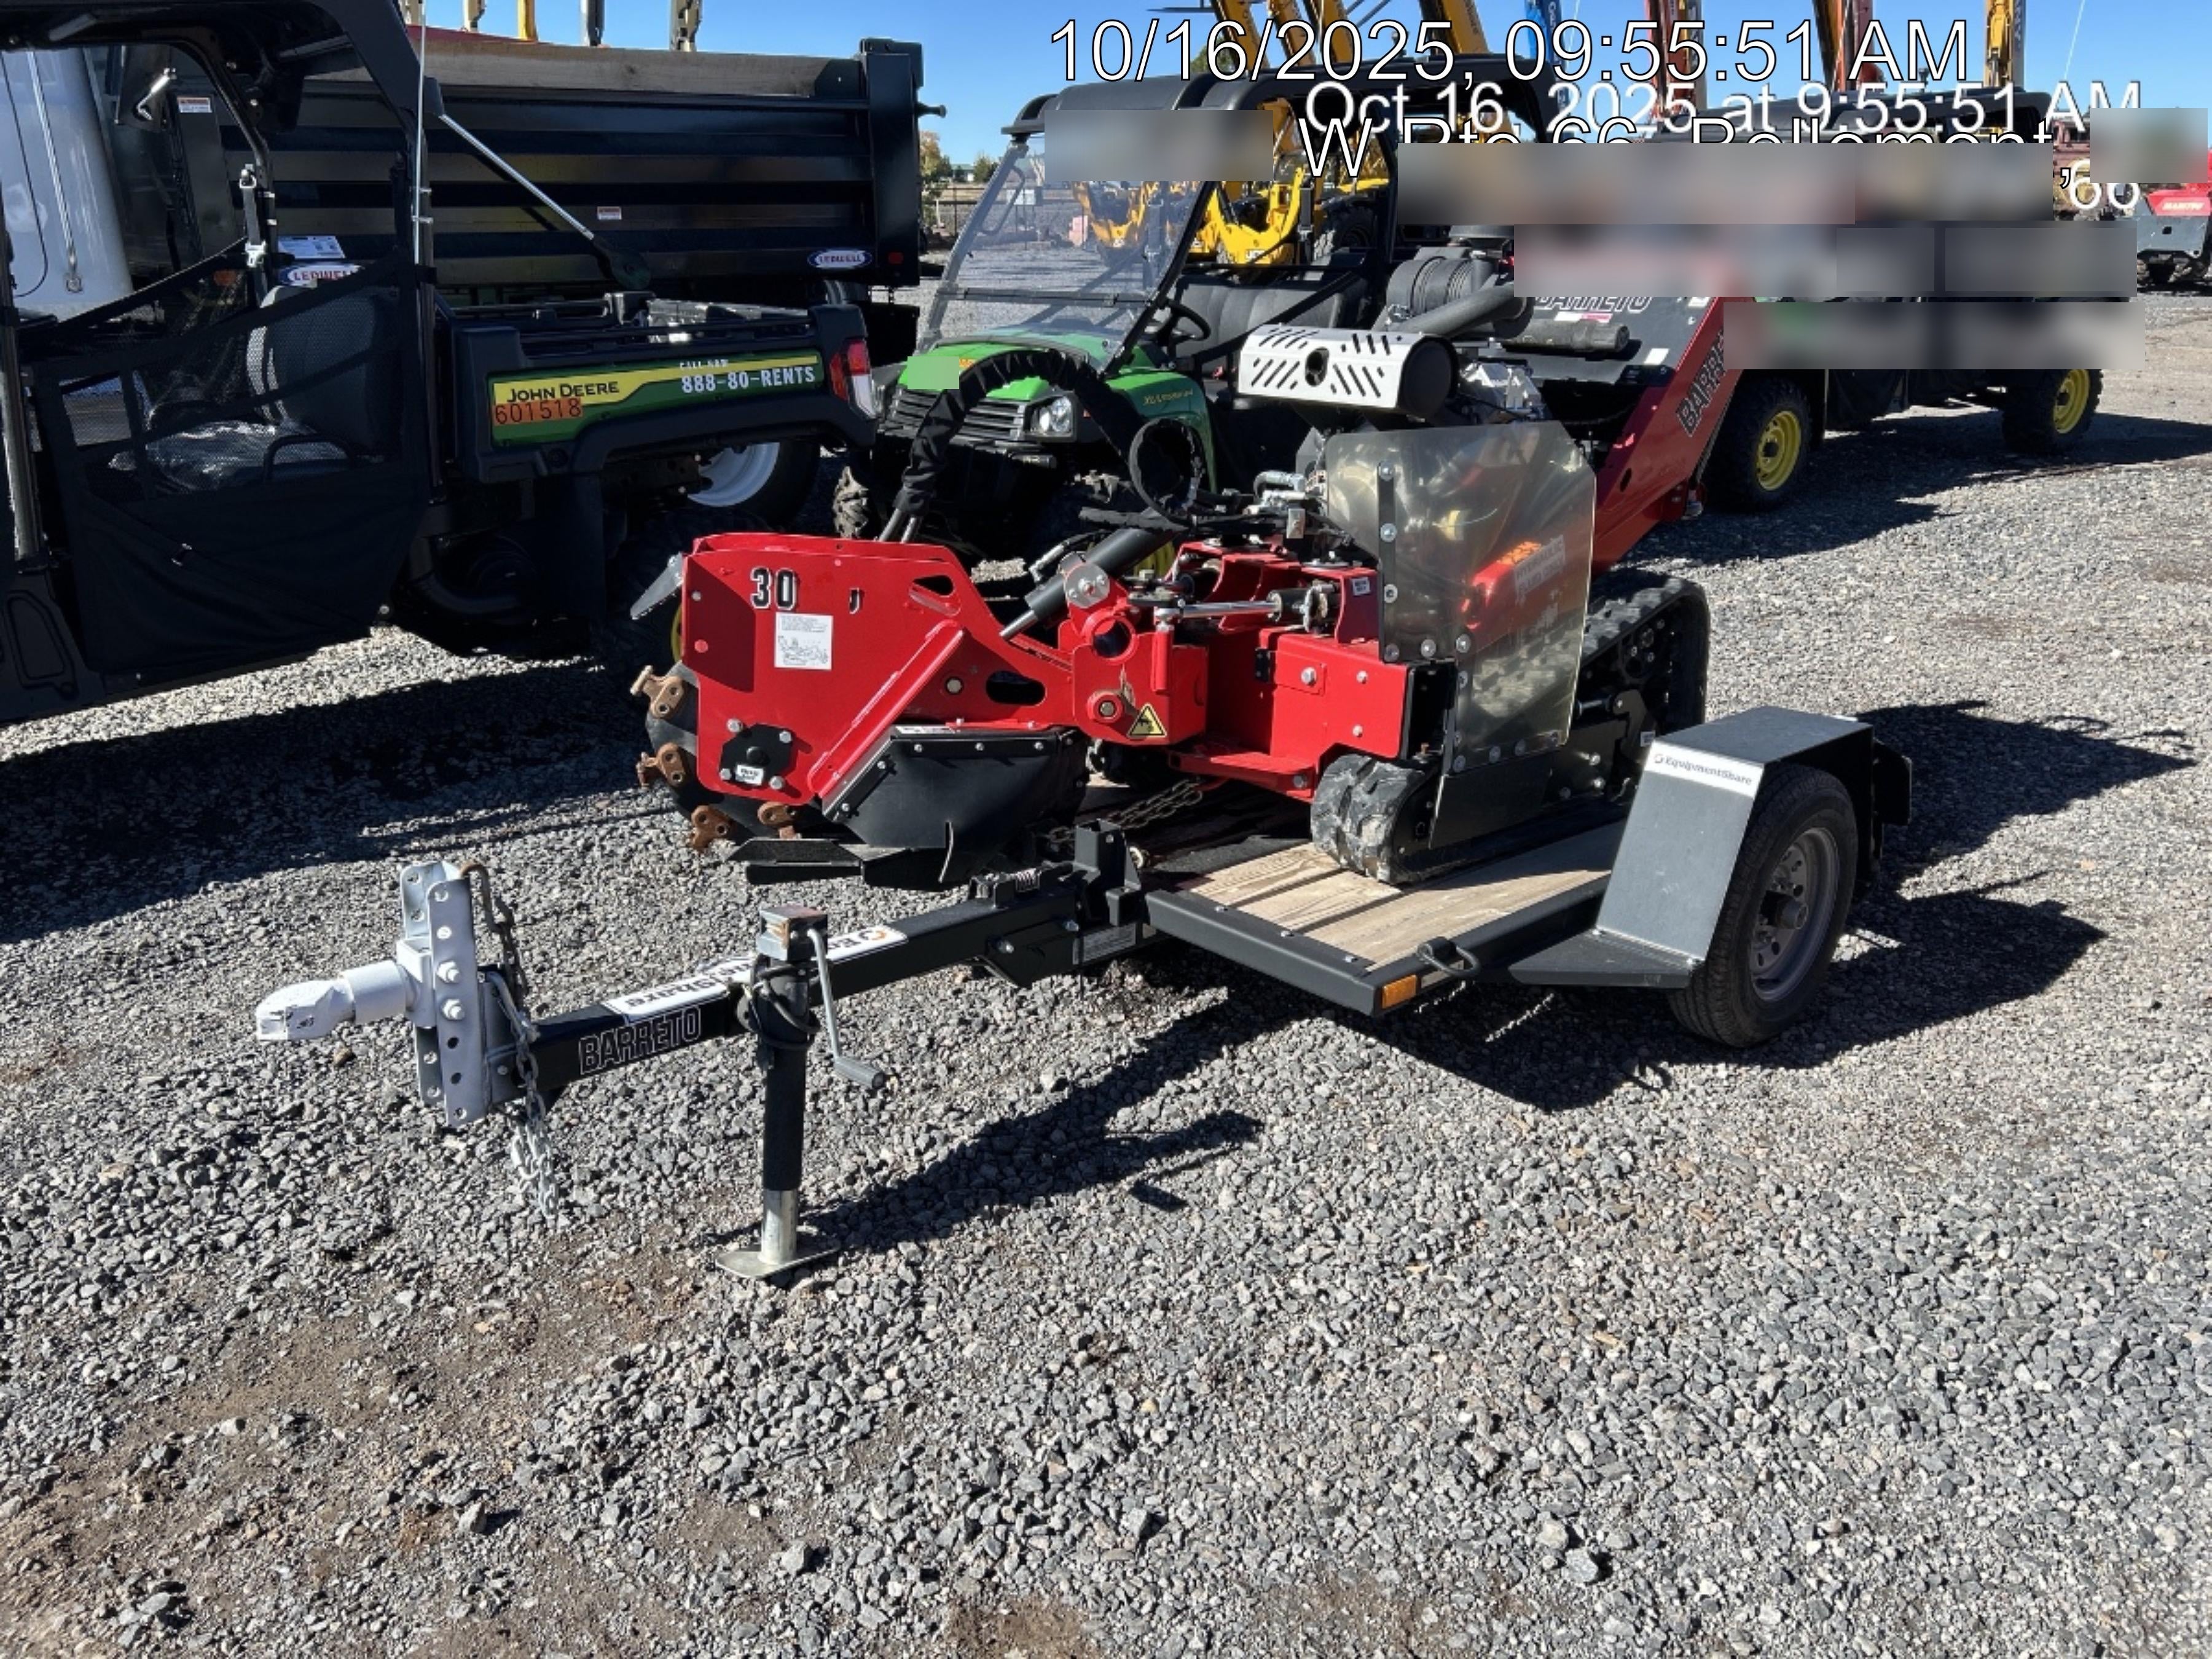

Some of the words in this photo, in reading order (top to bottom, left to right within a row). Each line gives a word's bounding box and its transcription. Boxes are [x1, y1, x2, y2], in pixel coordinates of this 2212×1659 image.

[507, 387, 555, 402] JOHN
[560, 381, 620, 398] DEERE
[681, 366, 815, 393] 888-80-RENTS
[495, 398, 582, 425] 601518
[750, 567, 798, 611] 30
[1665, 756, 1752, 785] EquipmentShare
[578, 1005, 702, 1076] BARRETO
